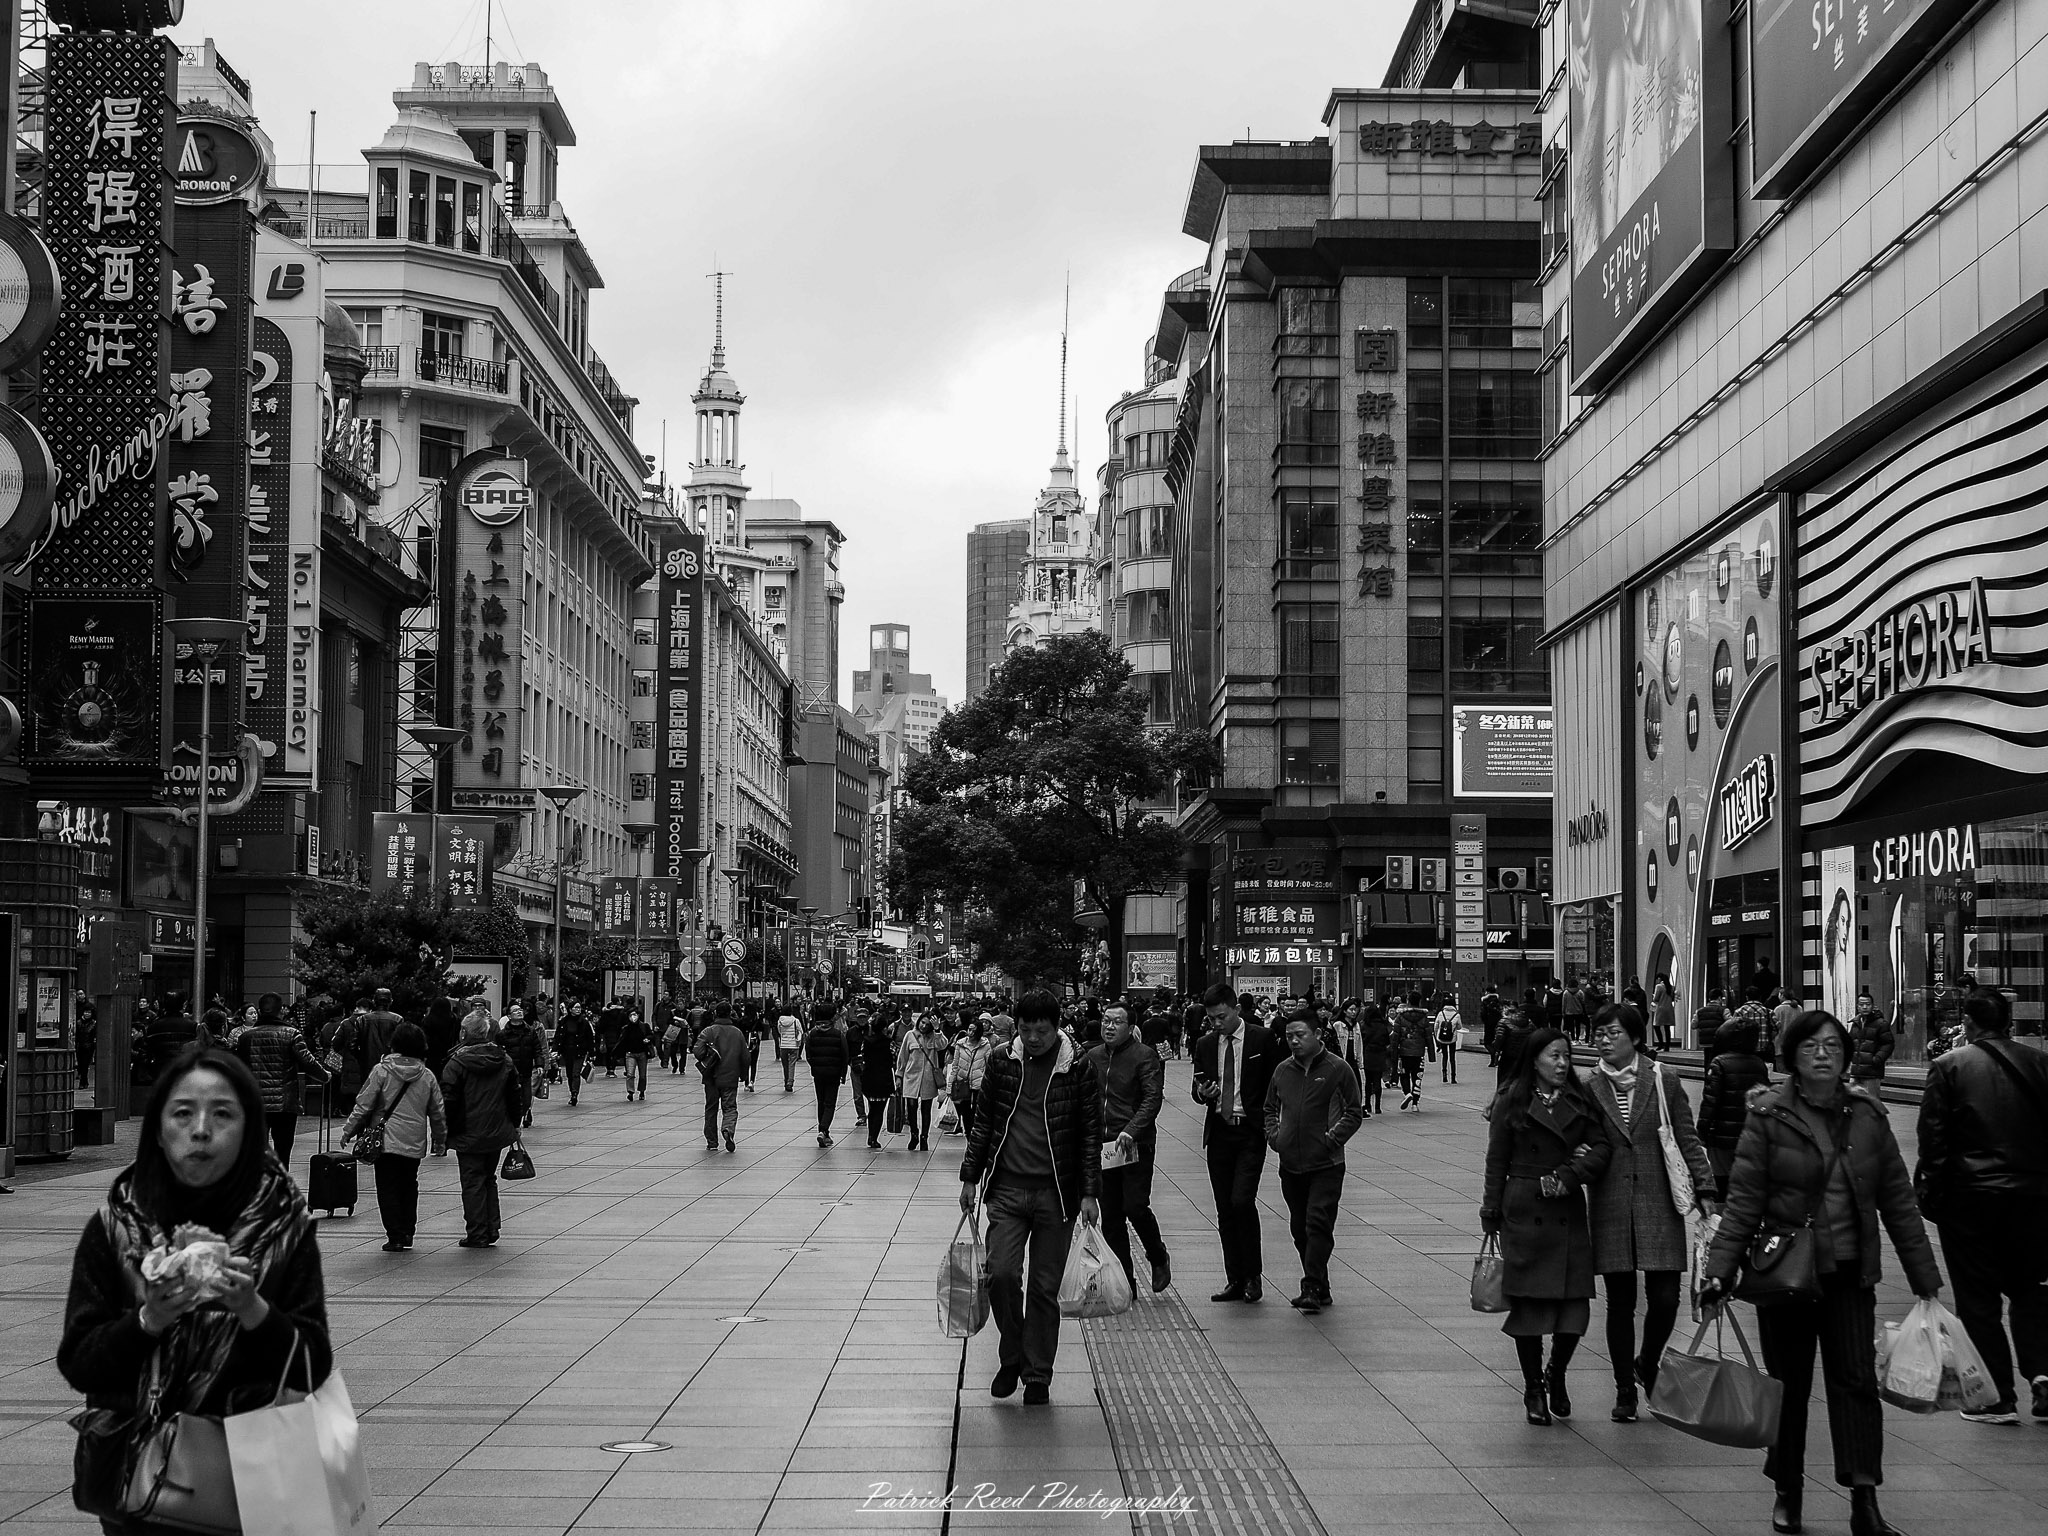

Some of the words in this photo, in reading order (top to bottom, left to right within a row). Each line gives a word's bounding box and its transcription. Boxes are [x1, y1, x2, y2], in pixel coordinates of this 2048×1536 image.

[1602, 200, 1661, 300] SEPHORA
[464, 489, 530, 505] BAC
[293, 553, 312, 610] No.1
[668, 589, 690, 770] 上海市第一食品商店
[1811, 576, 1992, 724] SEPHORA
[288, 626, 311, 753] Pharmacy
[670, 780, 684, 811] First
[668, 814, 684, 885] Foodha
[1568, 809, 1609, 847] PANDORA
[1872, 824, 1976, 884] SEPHORA
[1243, 905, 1315, 924] 新雅食品
